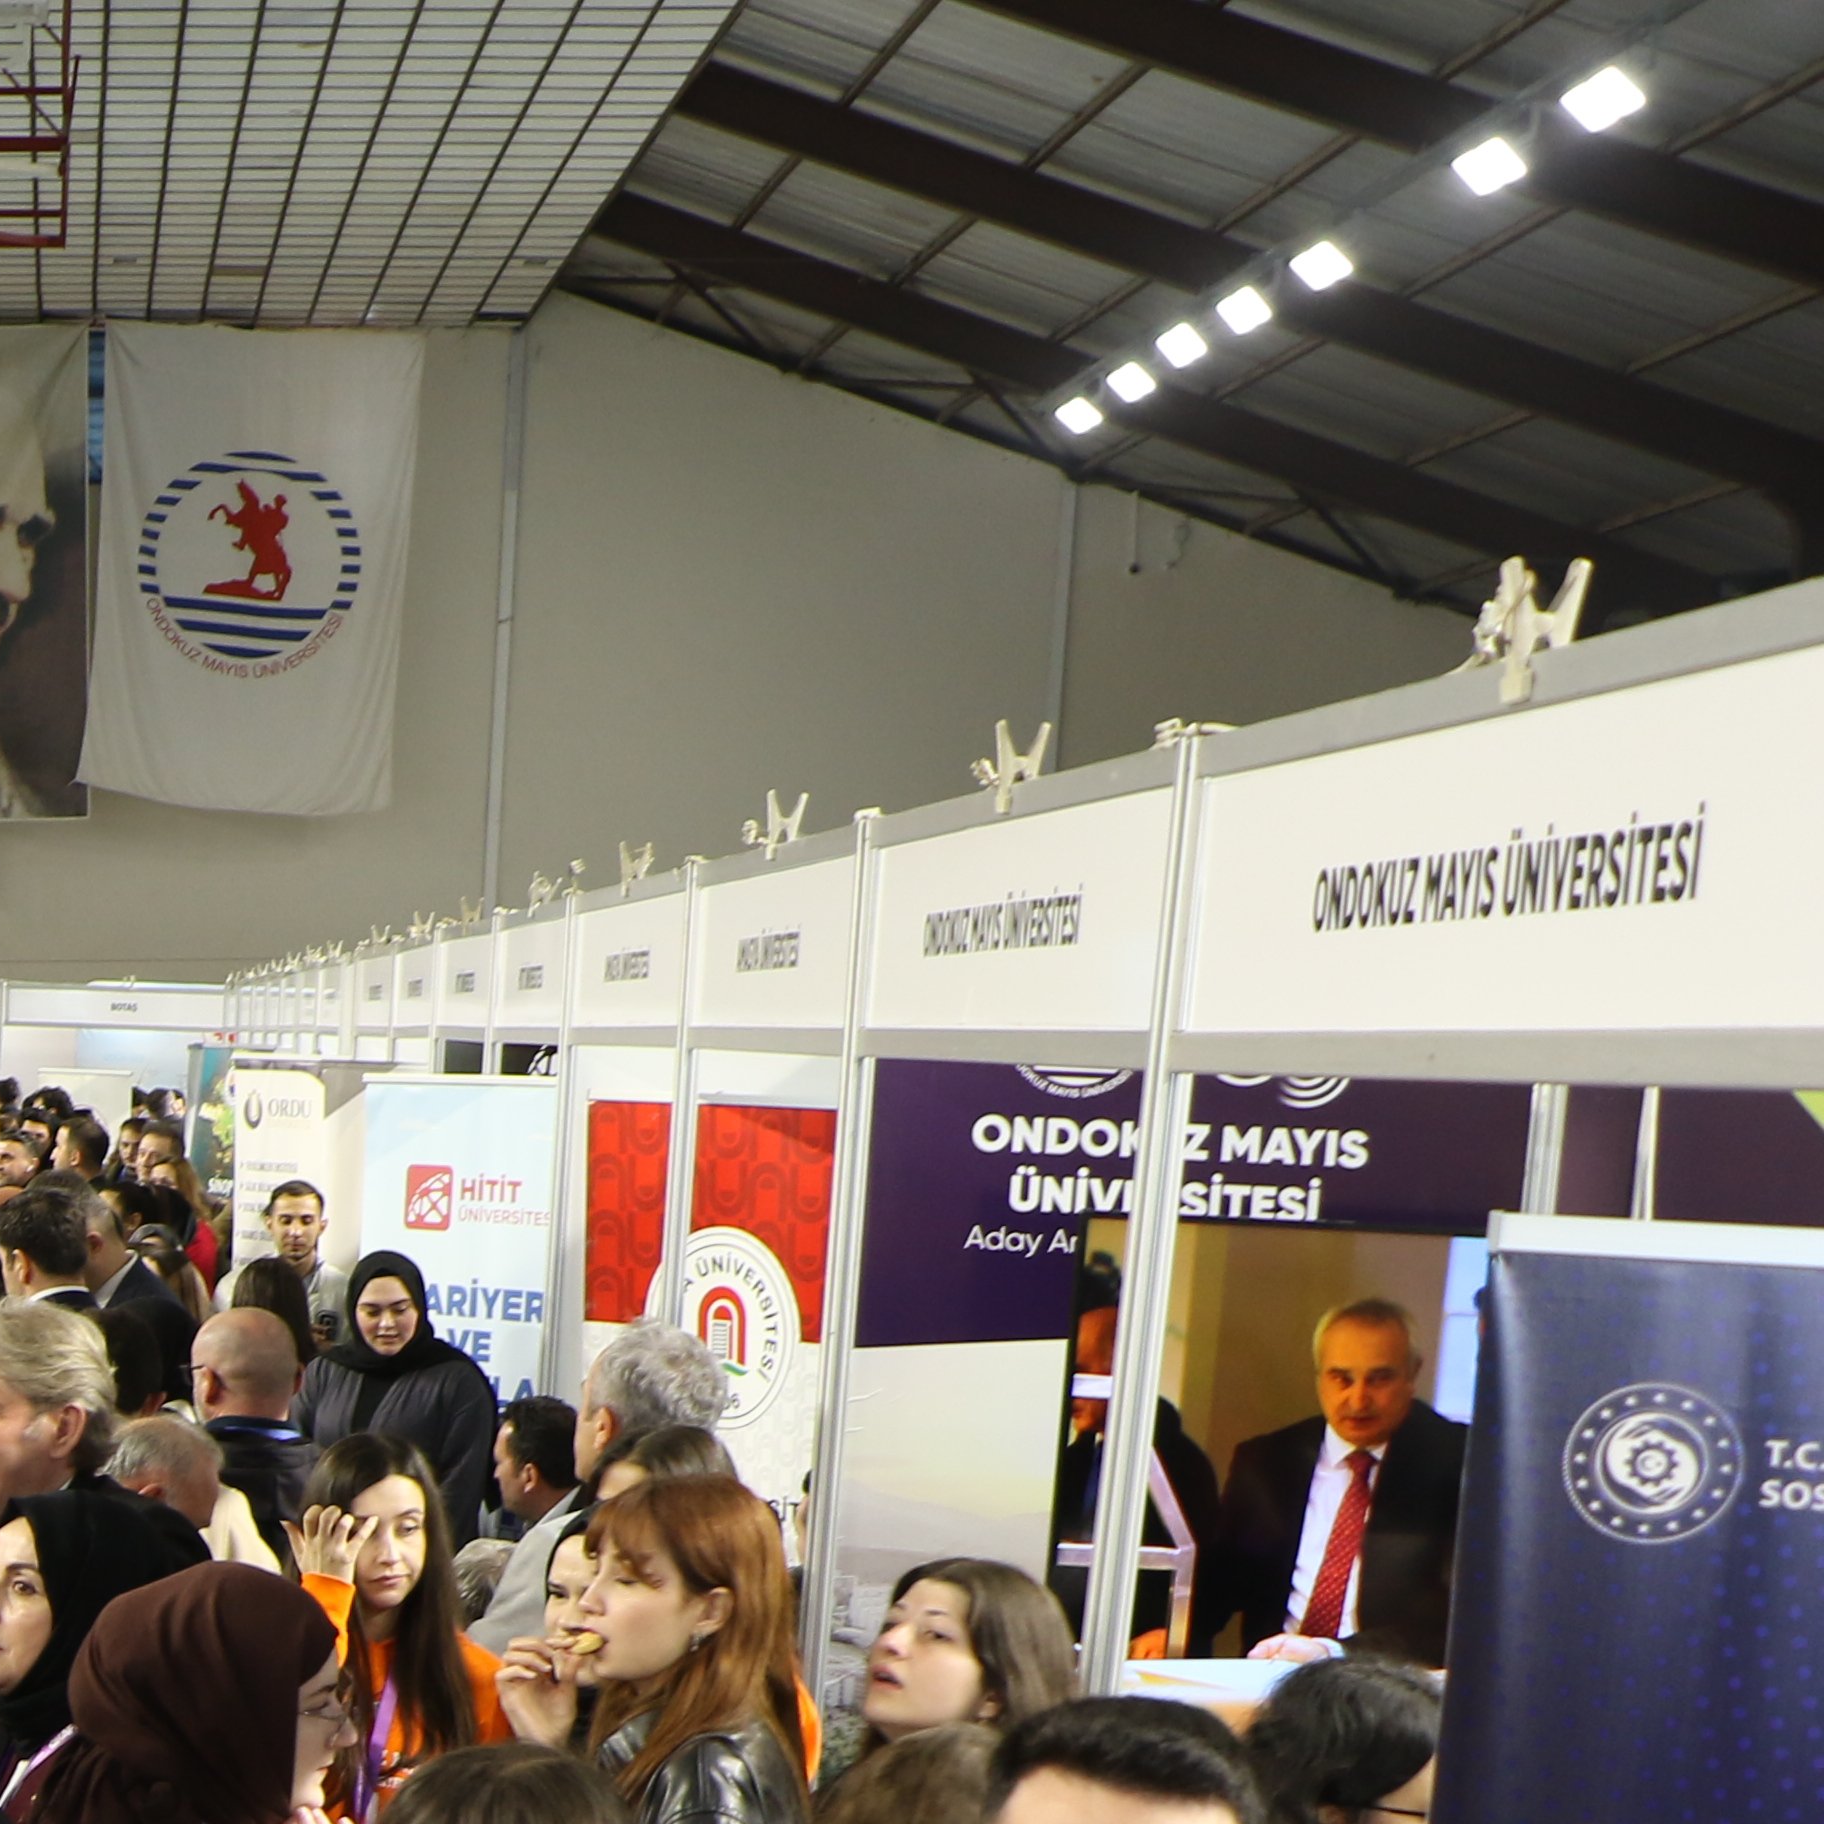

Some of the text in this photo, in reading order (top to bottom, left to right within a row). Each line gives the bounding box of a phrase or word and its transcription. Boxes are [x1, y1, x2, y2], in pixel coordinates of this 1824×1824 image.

[146, 598, 202, 662] ONDOKUZ
[203, 655, 248, 678] MAYIS
[1312, 800, 1706, 933] ONDOKUZ MAYIS ÜNİVERSİTESİ
[923, 882, 1084, 957] ONDOKUZ MAYIS ÜNİVERSİTESİ
[267, 1098, 312, 1118] ORDU
[972, 1113, 1370, 1170] ONDOKZ MAYIS
[458, 1204, 551, 1227] ÜNİVERSİTES
[460, 1174, 522, 1203] HİTİT
[1008, 1165, 1323, 1221] ÜNİVSİTESİ
[964, 1224, 1043, 1258] Aday
[425, 1278, 545, 1323] ARİYER
[696, 1252, 779, 1382] ÜNİVERSİTESİ
